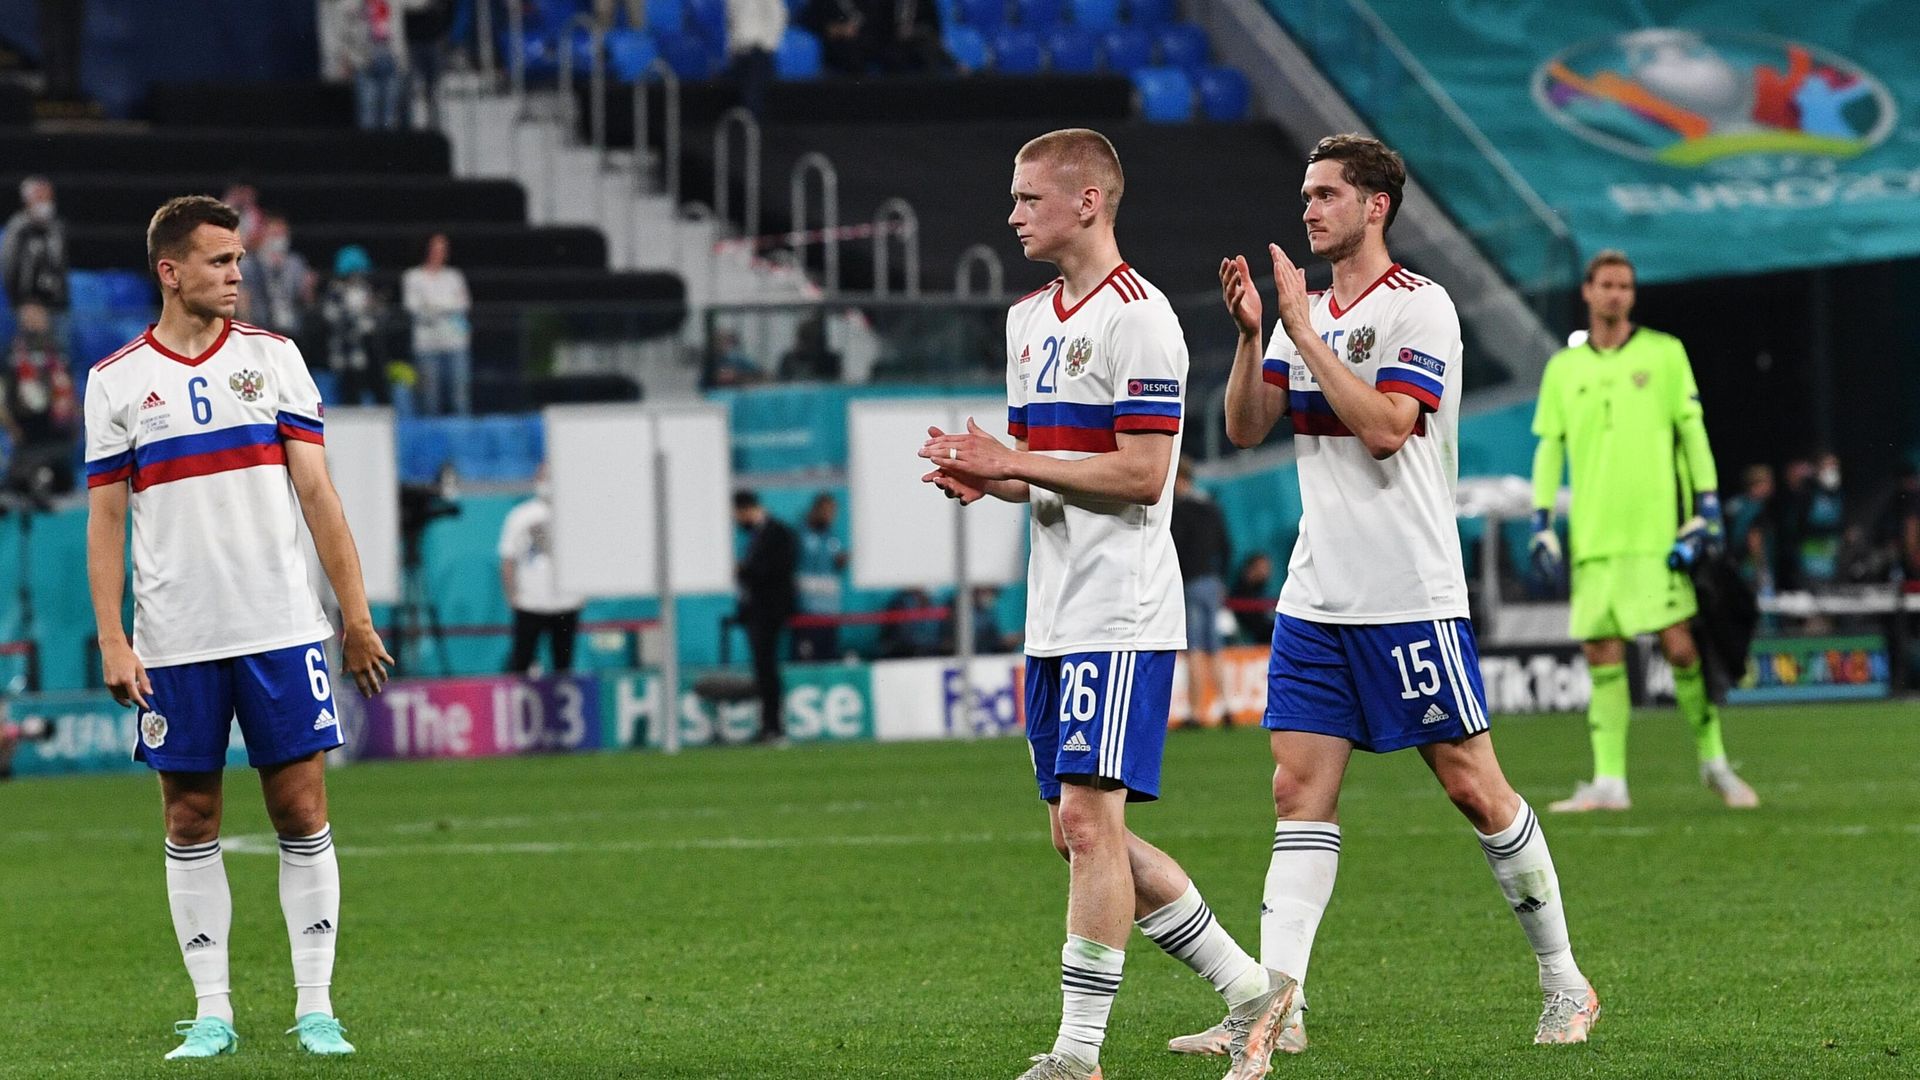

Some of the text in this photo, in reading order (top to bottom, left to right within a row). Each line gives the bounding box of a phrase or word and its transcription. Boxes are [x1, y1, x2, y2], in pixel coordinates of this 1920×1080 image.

[1143, 383, 1178, 393] RESPECT
[1412, 354, 1444, 373] RESPECT
[188, 376, 212, 425] 6
[305, 647, 331, 701] 6
[1060, 661, 1099, 722] 26
[1391, 640, 1441, 699] 15
[387, 690, 473, 754] The
[1422, 713, 1450, 724] adidas
